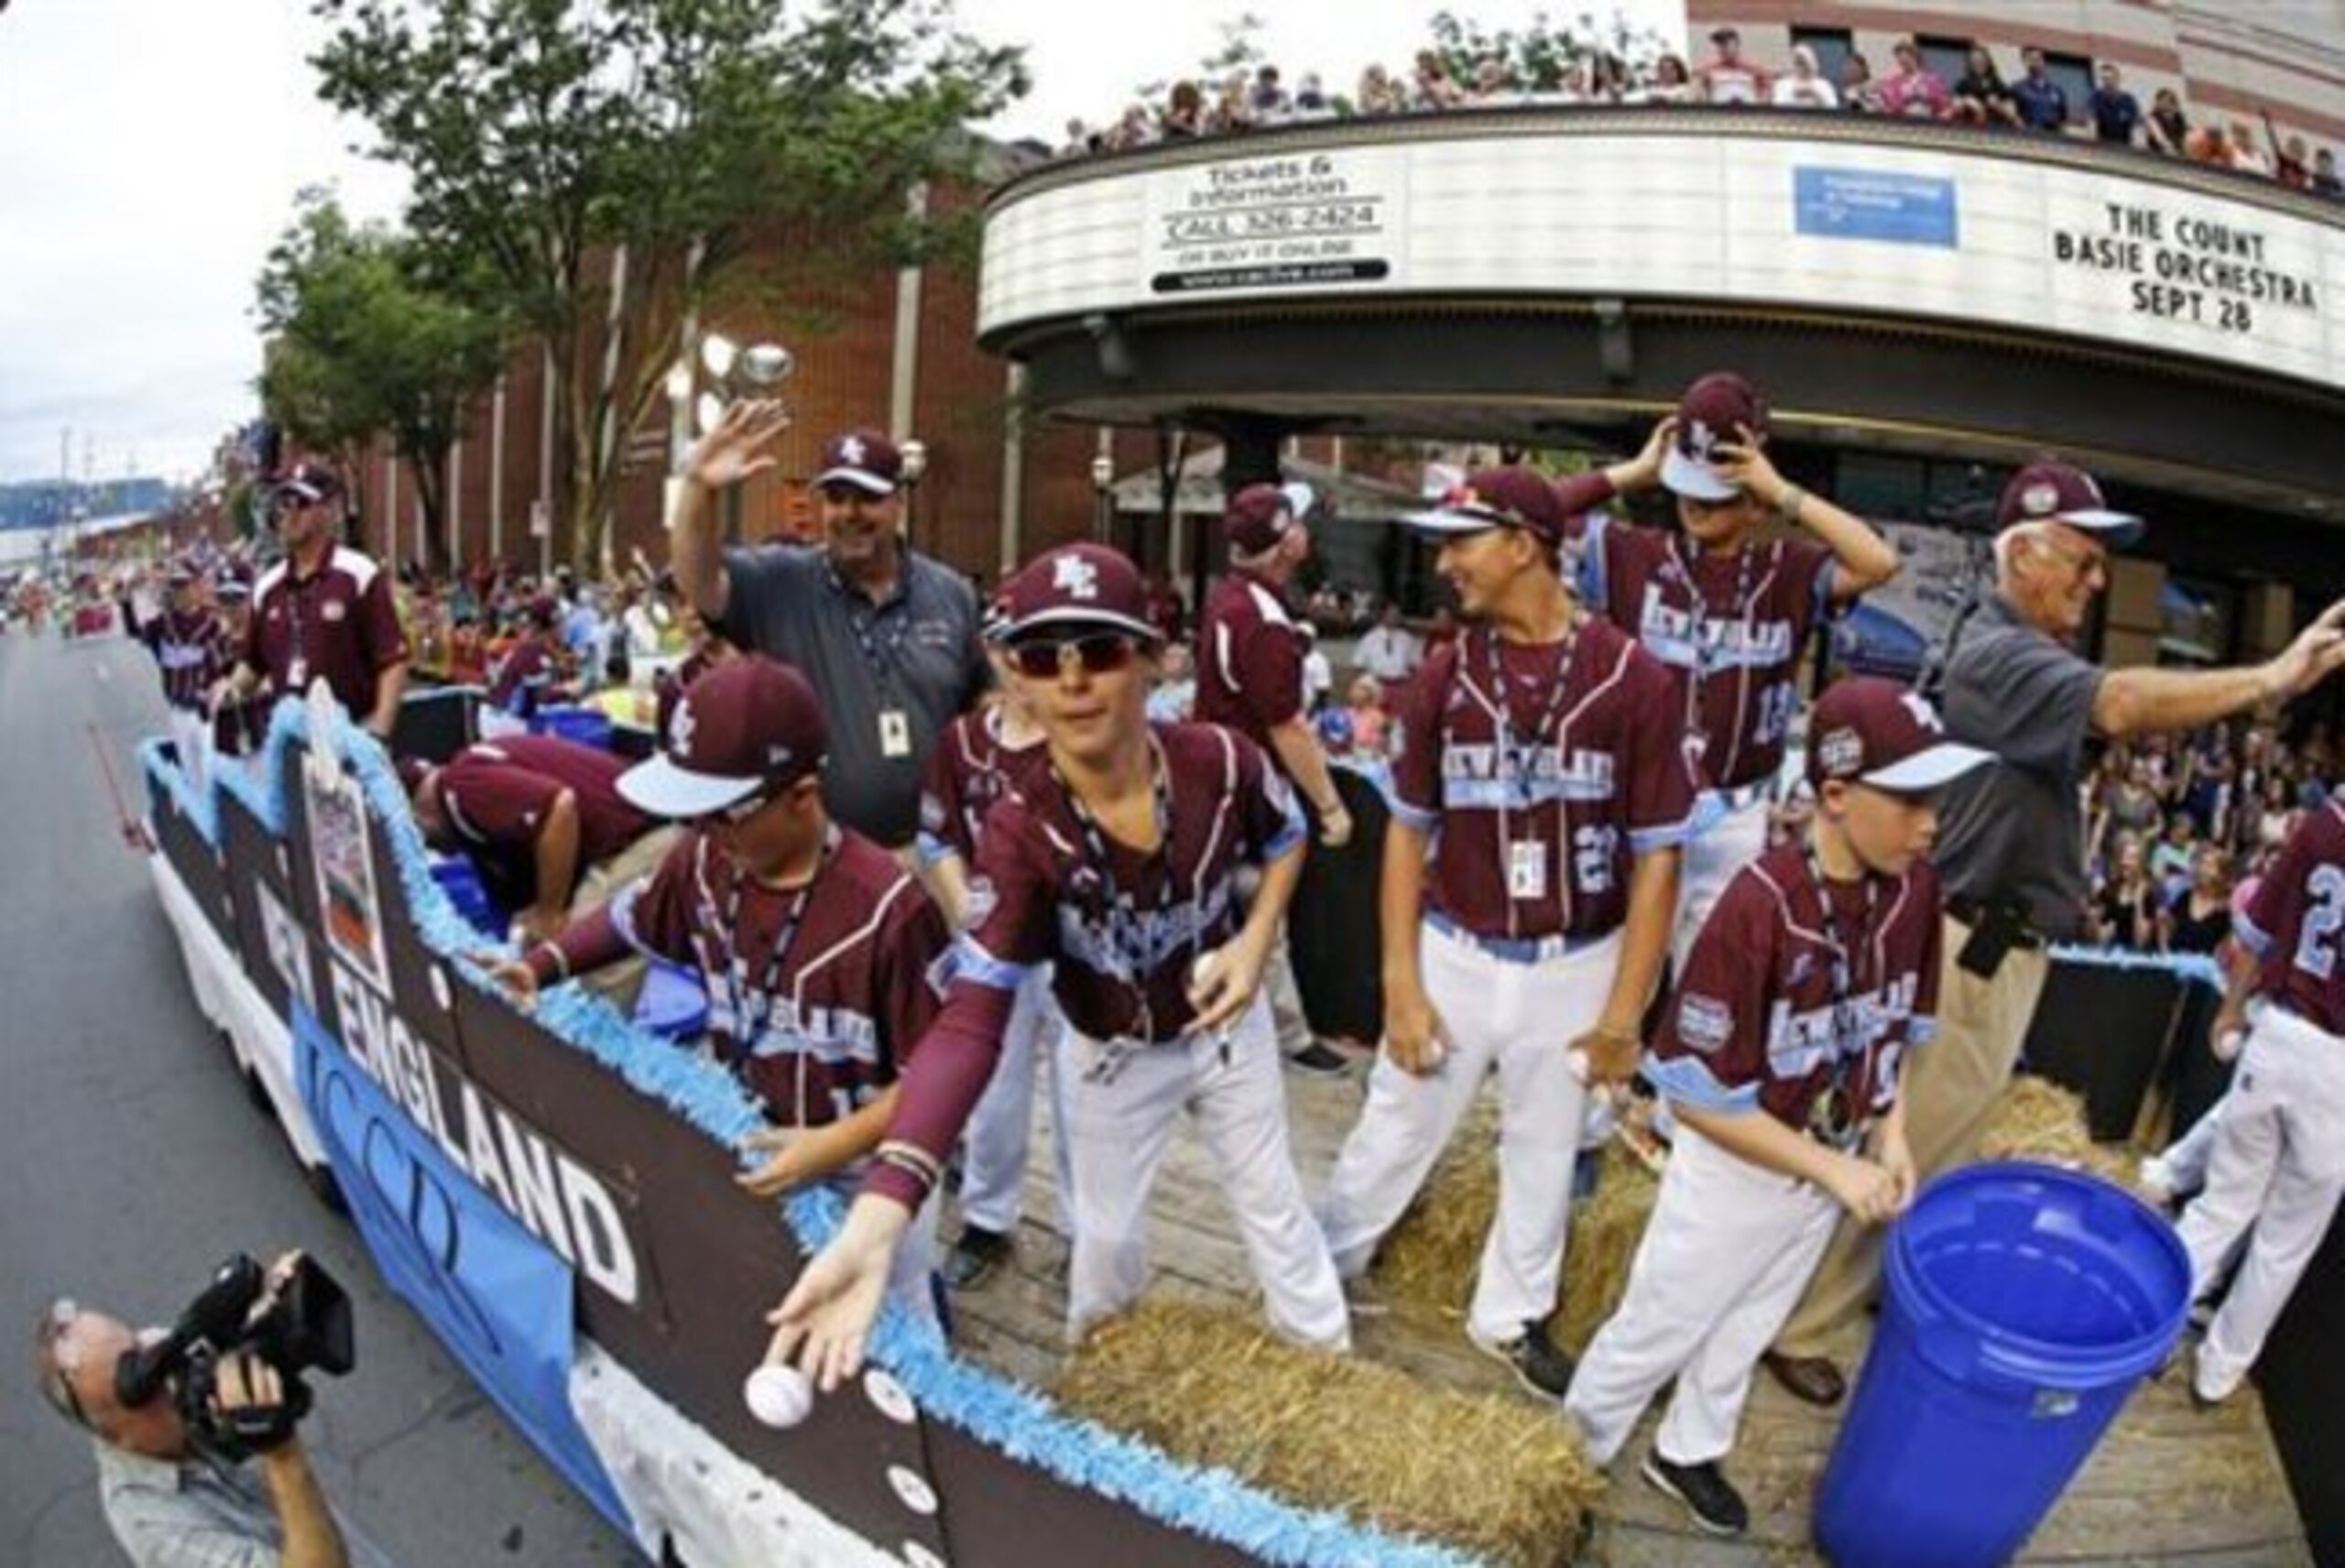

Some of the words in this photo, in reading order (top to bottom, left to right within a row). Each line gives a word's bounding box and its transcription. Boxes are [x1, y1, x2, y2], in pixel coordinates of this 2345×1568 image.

[1208, 162, 1301, 185] Tickets
[2107, 203, 2163, 242] THE
[2174, 216, 2265, 263] COUNT
[2054, 230, 2144, 274] BASIE
[2154, 248, 2318, 310] ORCHESTRA
[2131, 280, 2205, 321] SEPT
[2218, 298, 2252, 332] 28
[330, 958, 638, 1306] ENGLAND
